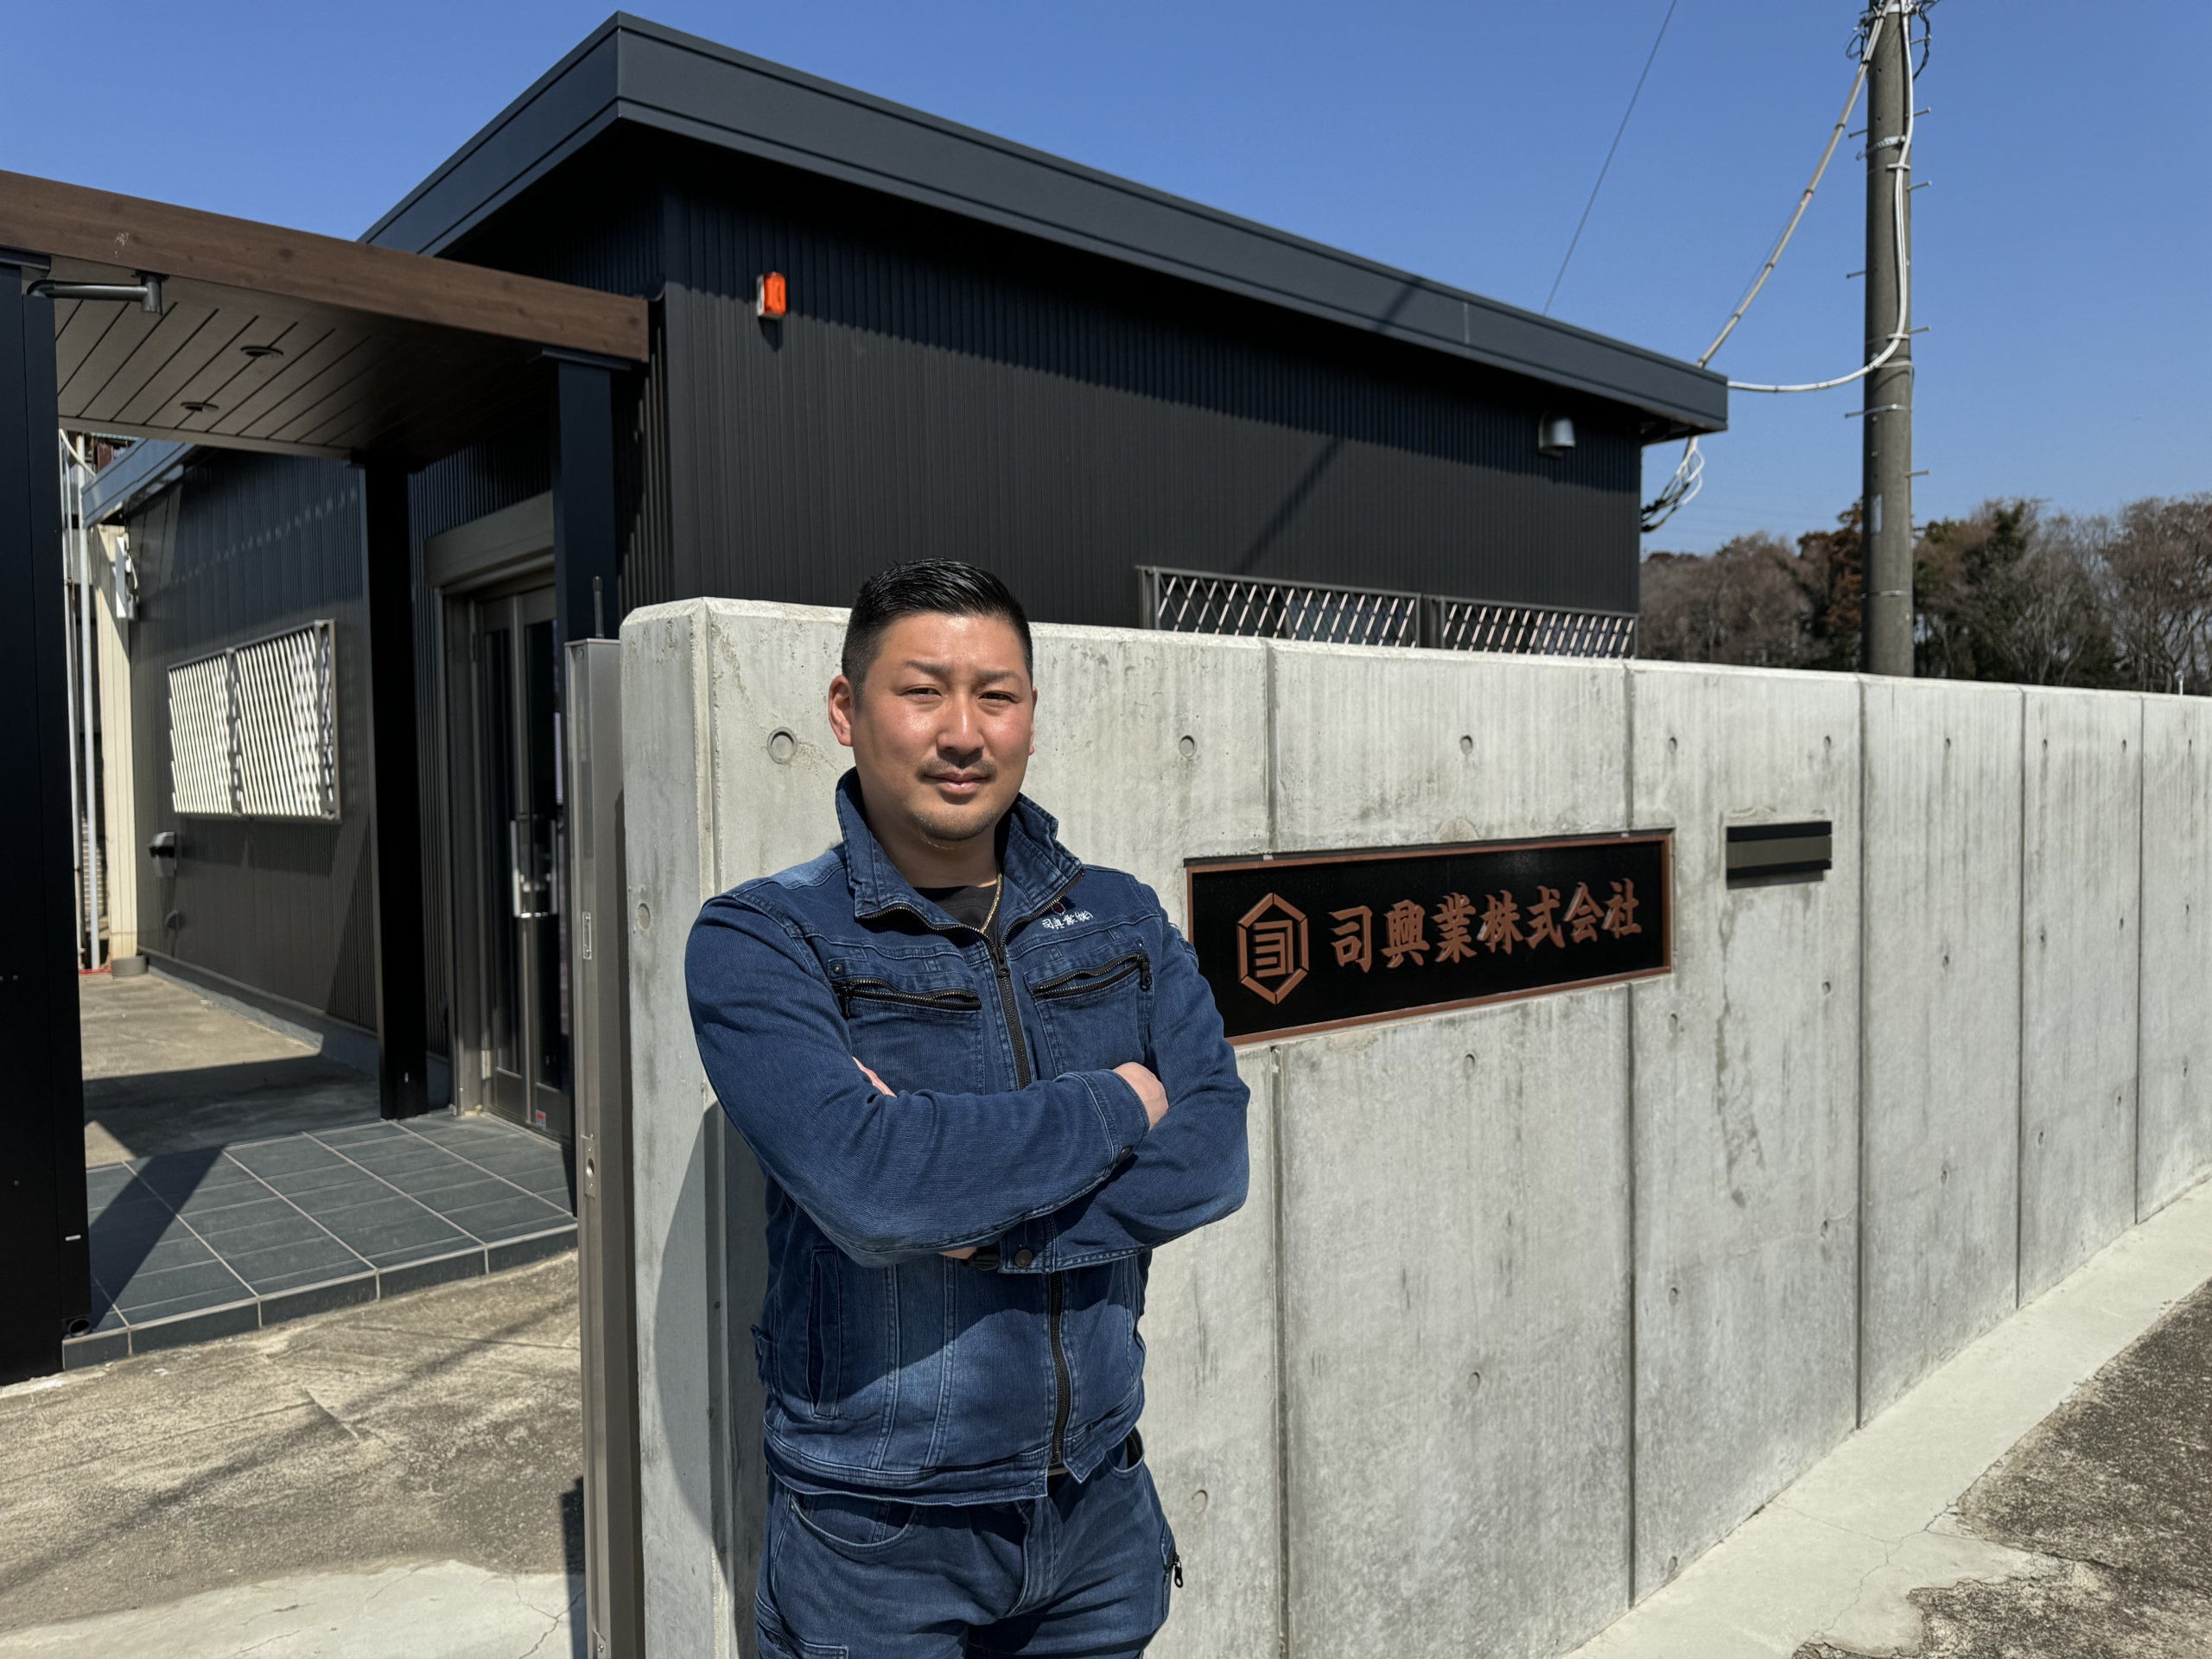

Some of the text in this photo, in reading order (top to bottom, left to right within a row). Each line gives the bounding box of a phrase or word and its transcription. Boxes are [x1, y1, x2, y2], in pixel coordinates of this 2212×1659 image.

[1328, 877, 1643, 974] 司興業株式会社
